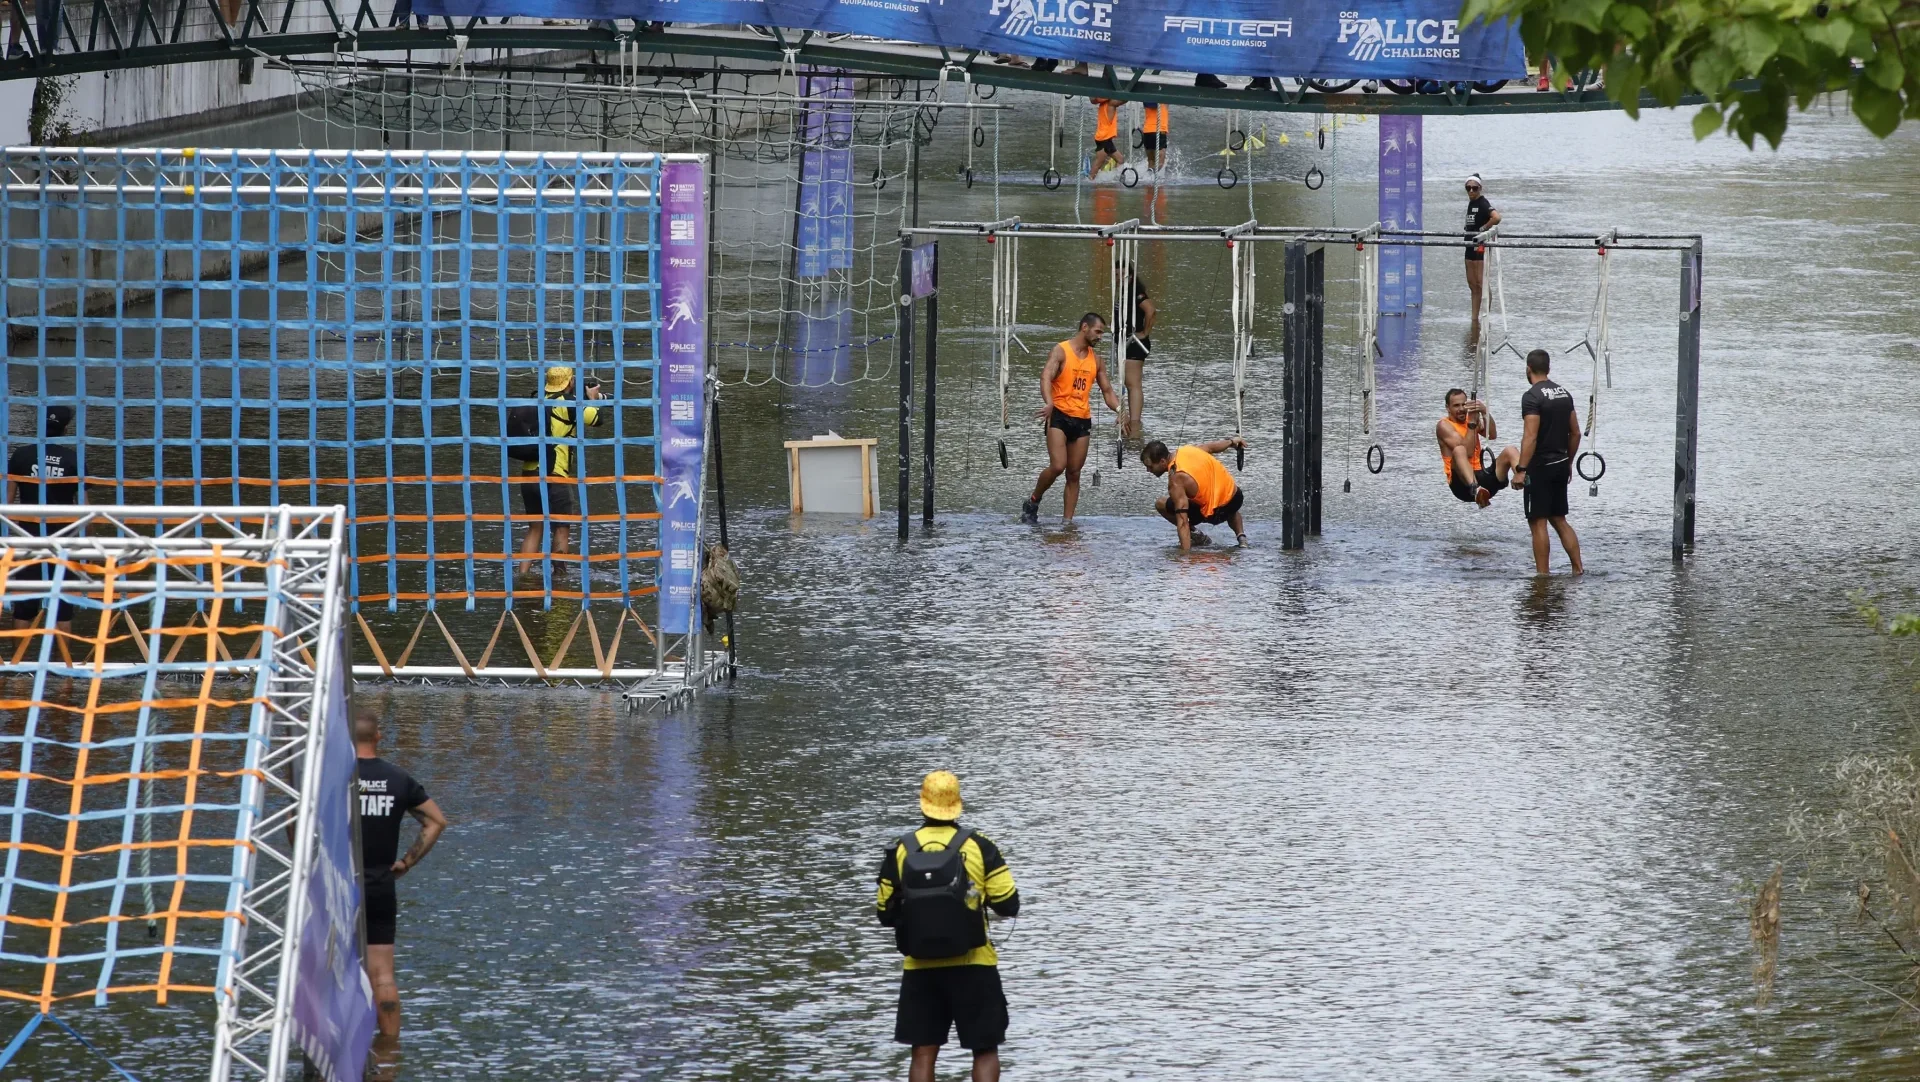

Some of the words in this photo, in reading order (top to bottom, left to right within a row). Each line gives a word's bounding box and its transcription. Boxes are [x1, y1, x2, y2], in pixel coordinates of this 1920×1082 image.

[884, 2, 919, 13] GINÁSIOS
[1339, 11, 1359, 19] OCR
[1033, 25, 1111, 42] CHALLENGE
[1187, 36, 1231, 46] EQUIPAMOS
[1231, 38, 1267, 48] GINÁSIOS
[1381, 48, 1460, 58] CHALLENGE
[671, 401, 687, 419] NO
[31, 464, 64, 477] SAFF
[359, 794, 395, 816] TAFF
